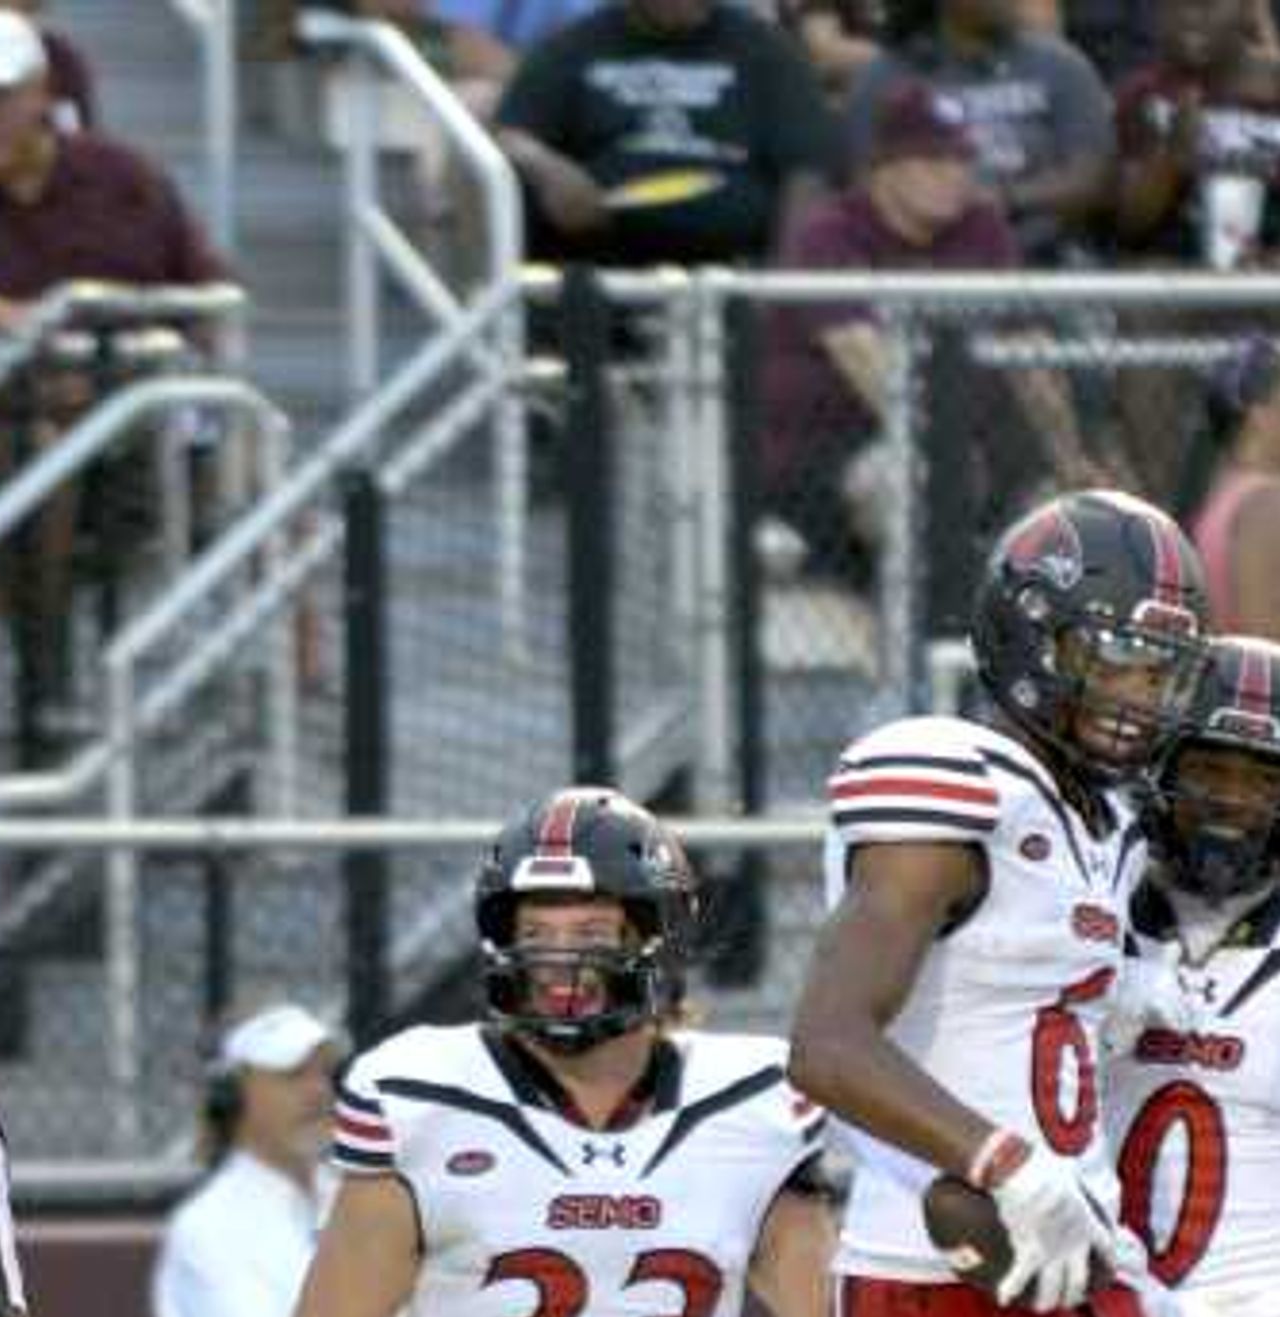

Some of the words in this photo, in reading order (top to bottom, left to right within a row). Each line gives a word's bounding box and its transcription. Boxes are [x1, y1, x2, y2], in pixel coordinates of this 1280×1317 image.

[1031, 965, 1116, 1157] 6
[546, 1194, 661, 1230] SEMO
[1116, 1079, 1228, 1289] 0
